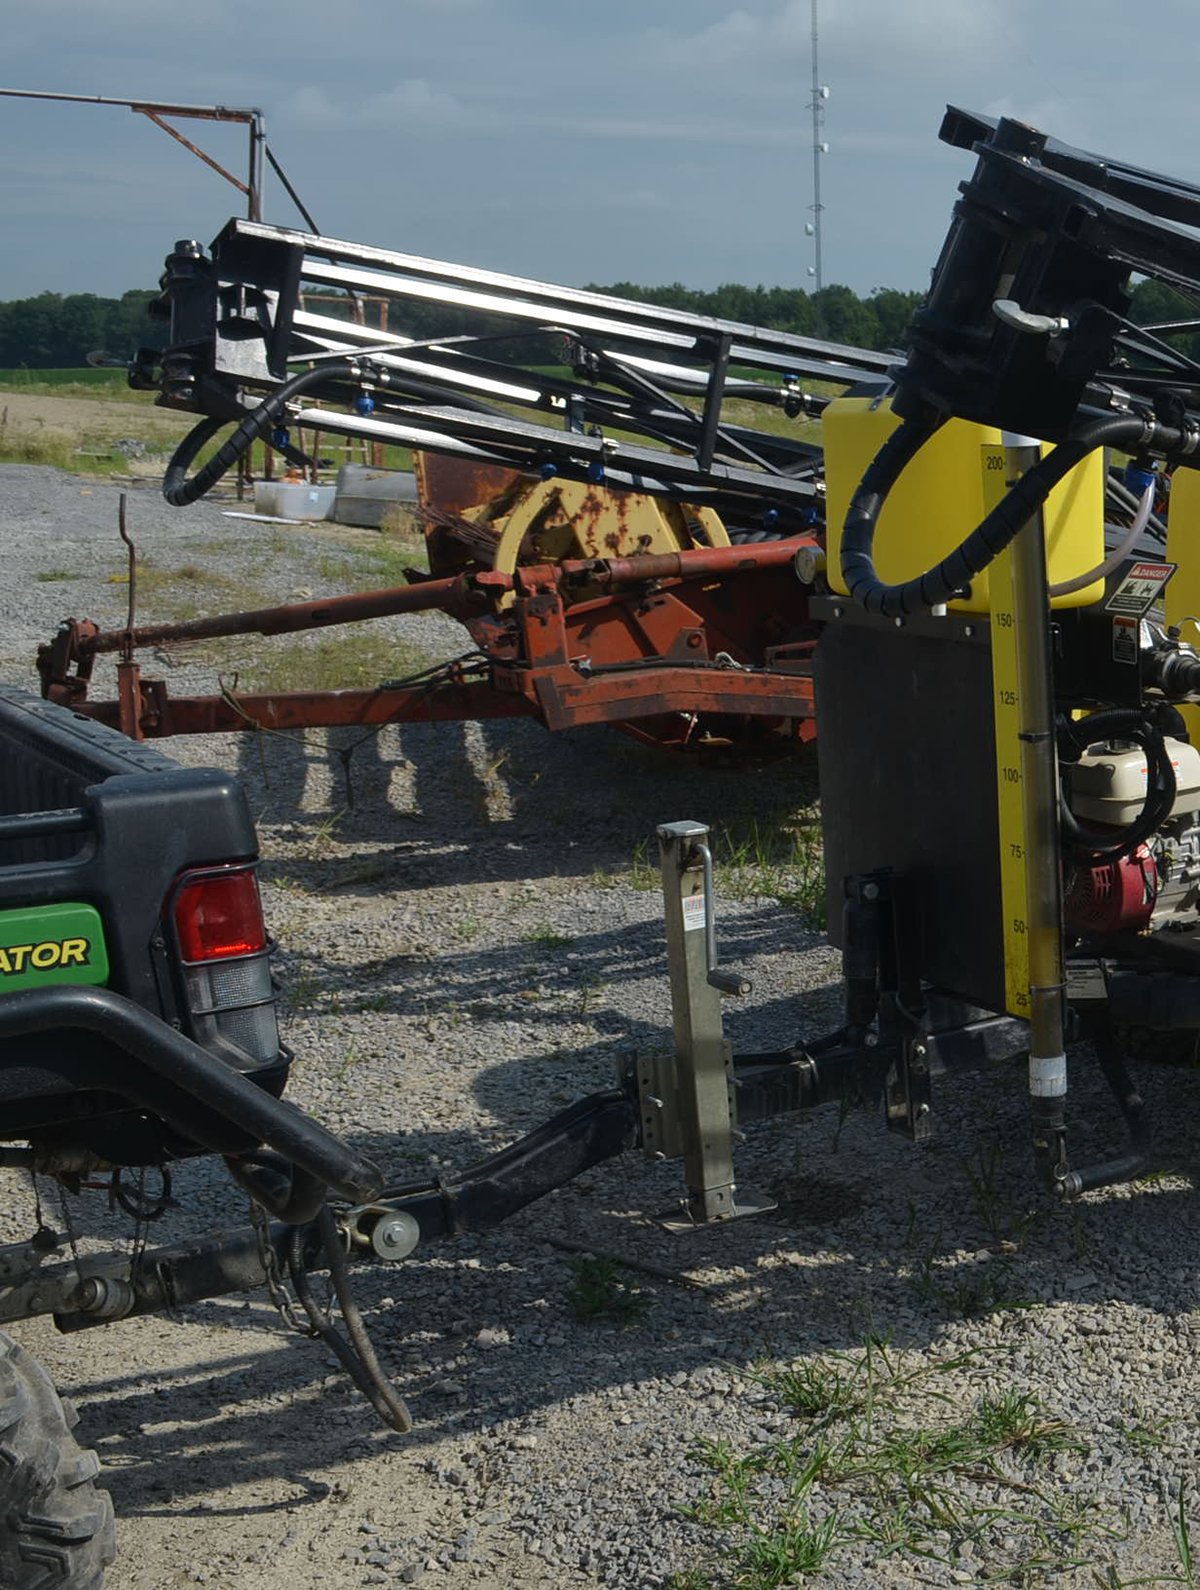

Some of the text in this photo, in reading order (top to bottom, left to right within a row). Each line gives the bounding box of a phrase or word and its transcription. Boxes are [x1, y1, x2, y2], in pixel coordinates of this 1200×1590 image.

[986, 455, 1003, 470] 200
[996, 613, 1012, 627] 150
[1000, 691, 1016, 705] 125
[1003, 767, 1019, 783] 100
[1010, 844, 1022, 859] 75
[1013, 919, 1025, 934] 50
[1015, 992, 1028, 1006] 25
